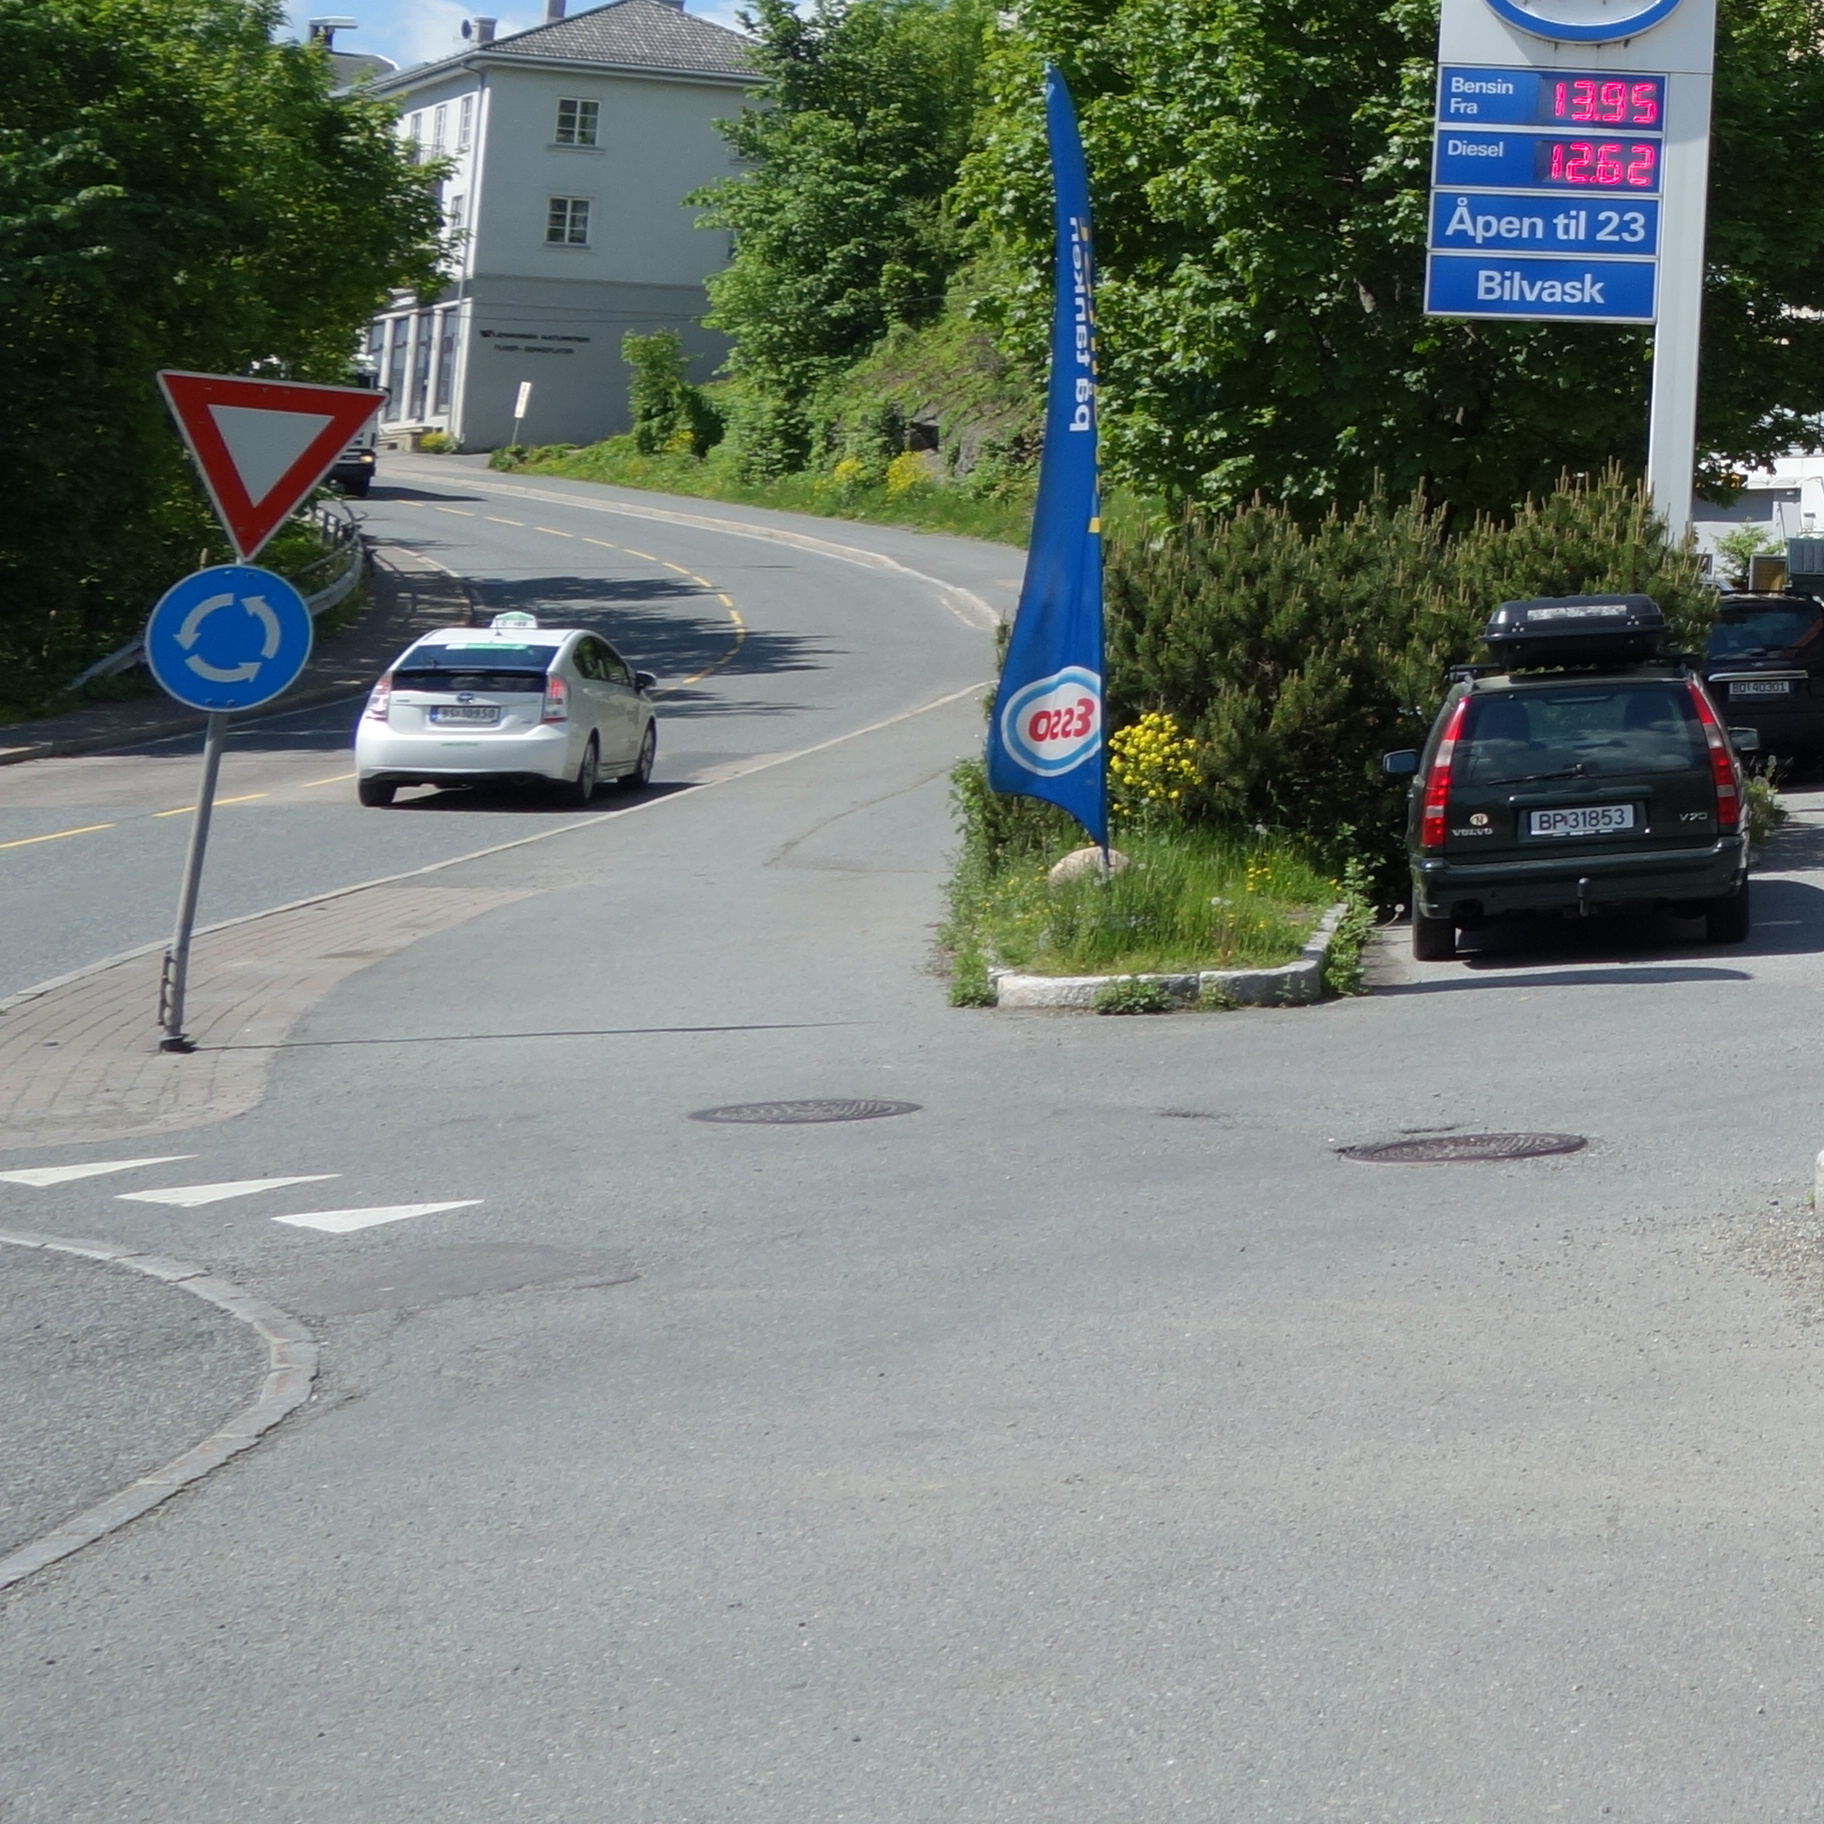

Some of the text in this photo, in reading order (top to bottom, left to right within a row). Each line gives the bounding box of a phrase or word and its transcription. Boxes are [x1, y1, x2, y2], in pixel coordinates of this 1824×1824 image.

[1450, 77, 1657, 123] Bensin 13.95
[1450, 98, 1478, 115] Fra
[1447, 140, 1654, 186] Diesel 12.62
[1444, 197, 1646, 244] Åpen til 23
[1477, 270, 1605, 304] Bilvask
[1451, 828, 1493, 837] VOLVO
[1538, 808, 1626, 831] BP 31853
